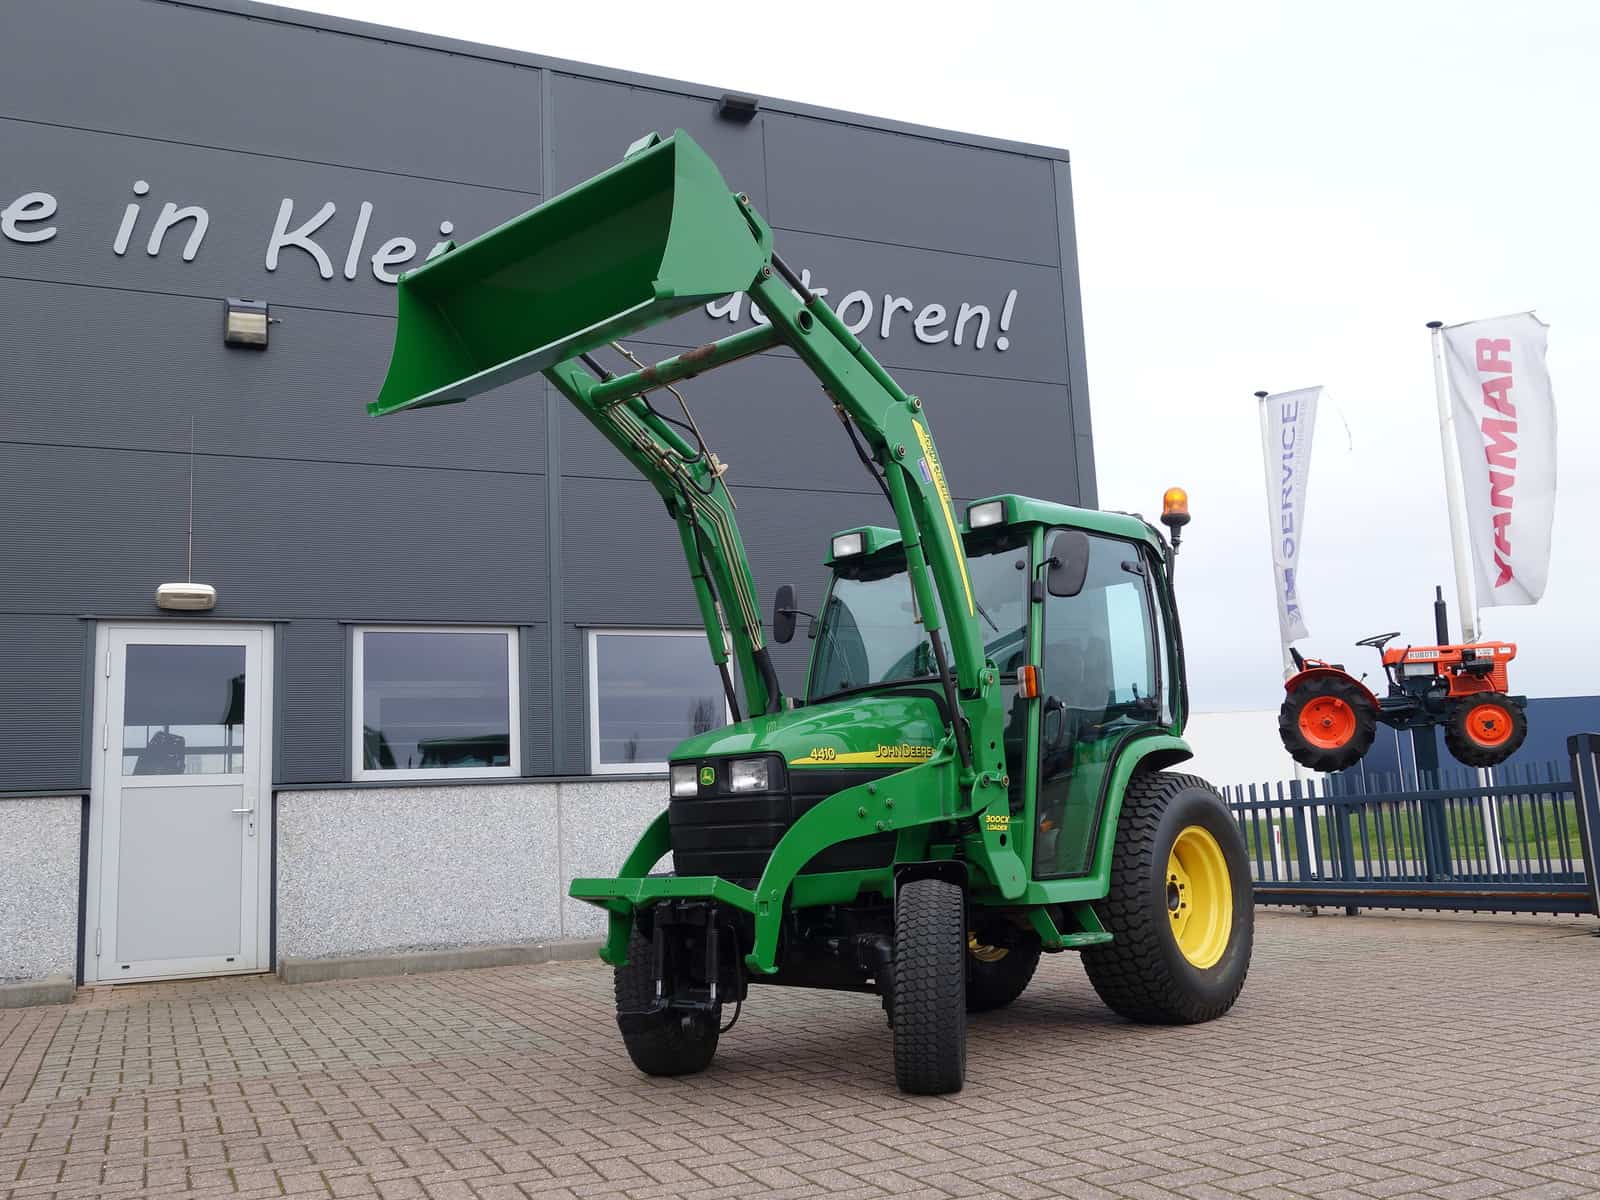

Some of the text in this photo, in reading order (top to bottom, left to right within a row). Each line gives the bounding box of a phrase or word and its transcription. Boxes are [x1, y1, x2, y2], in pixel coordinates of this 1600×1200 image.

[113, 180, 209, 262] in
[1281, 400, 1299, 559] SERVICE
[1476, 337, 1518, 589] YANMAR
[810, 747, 836, 760] 4410
